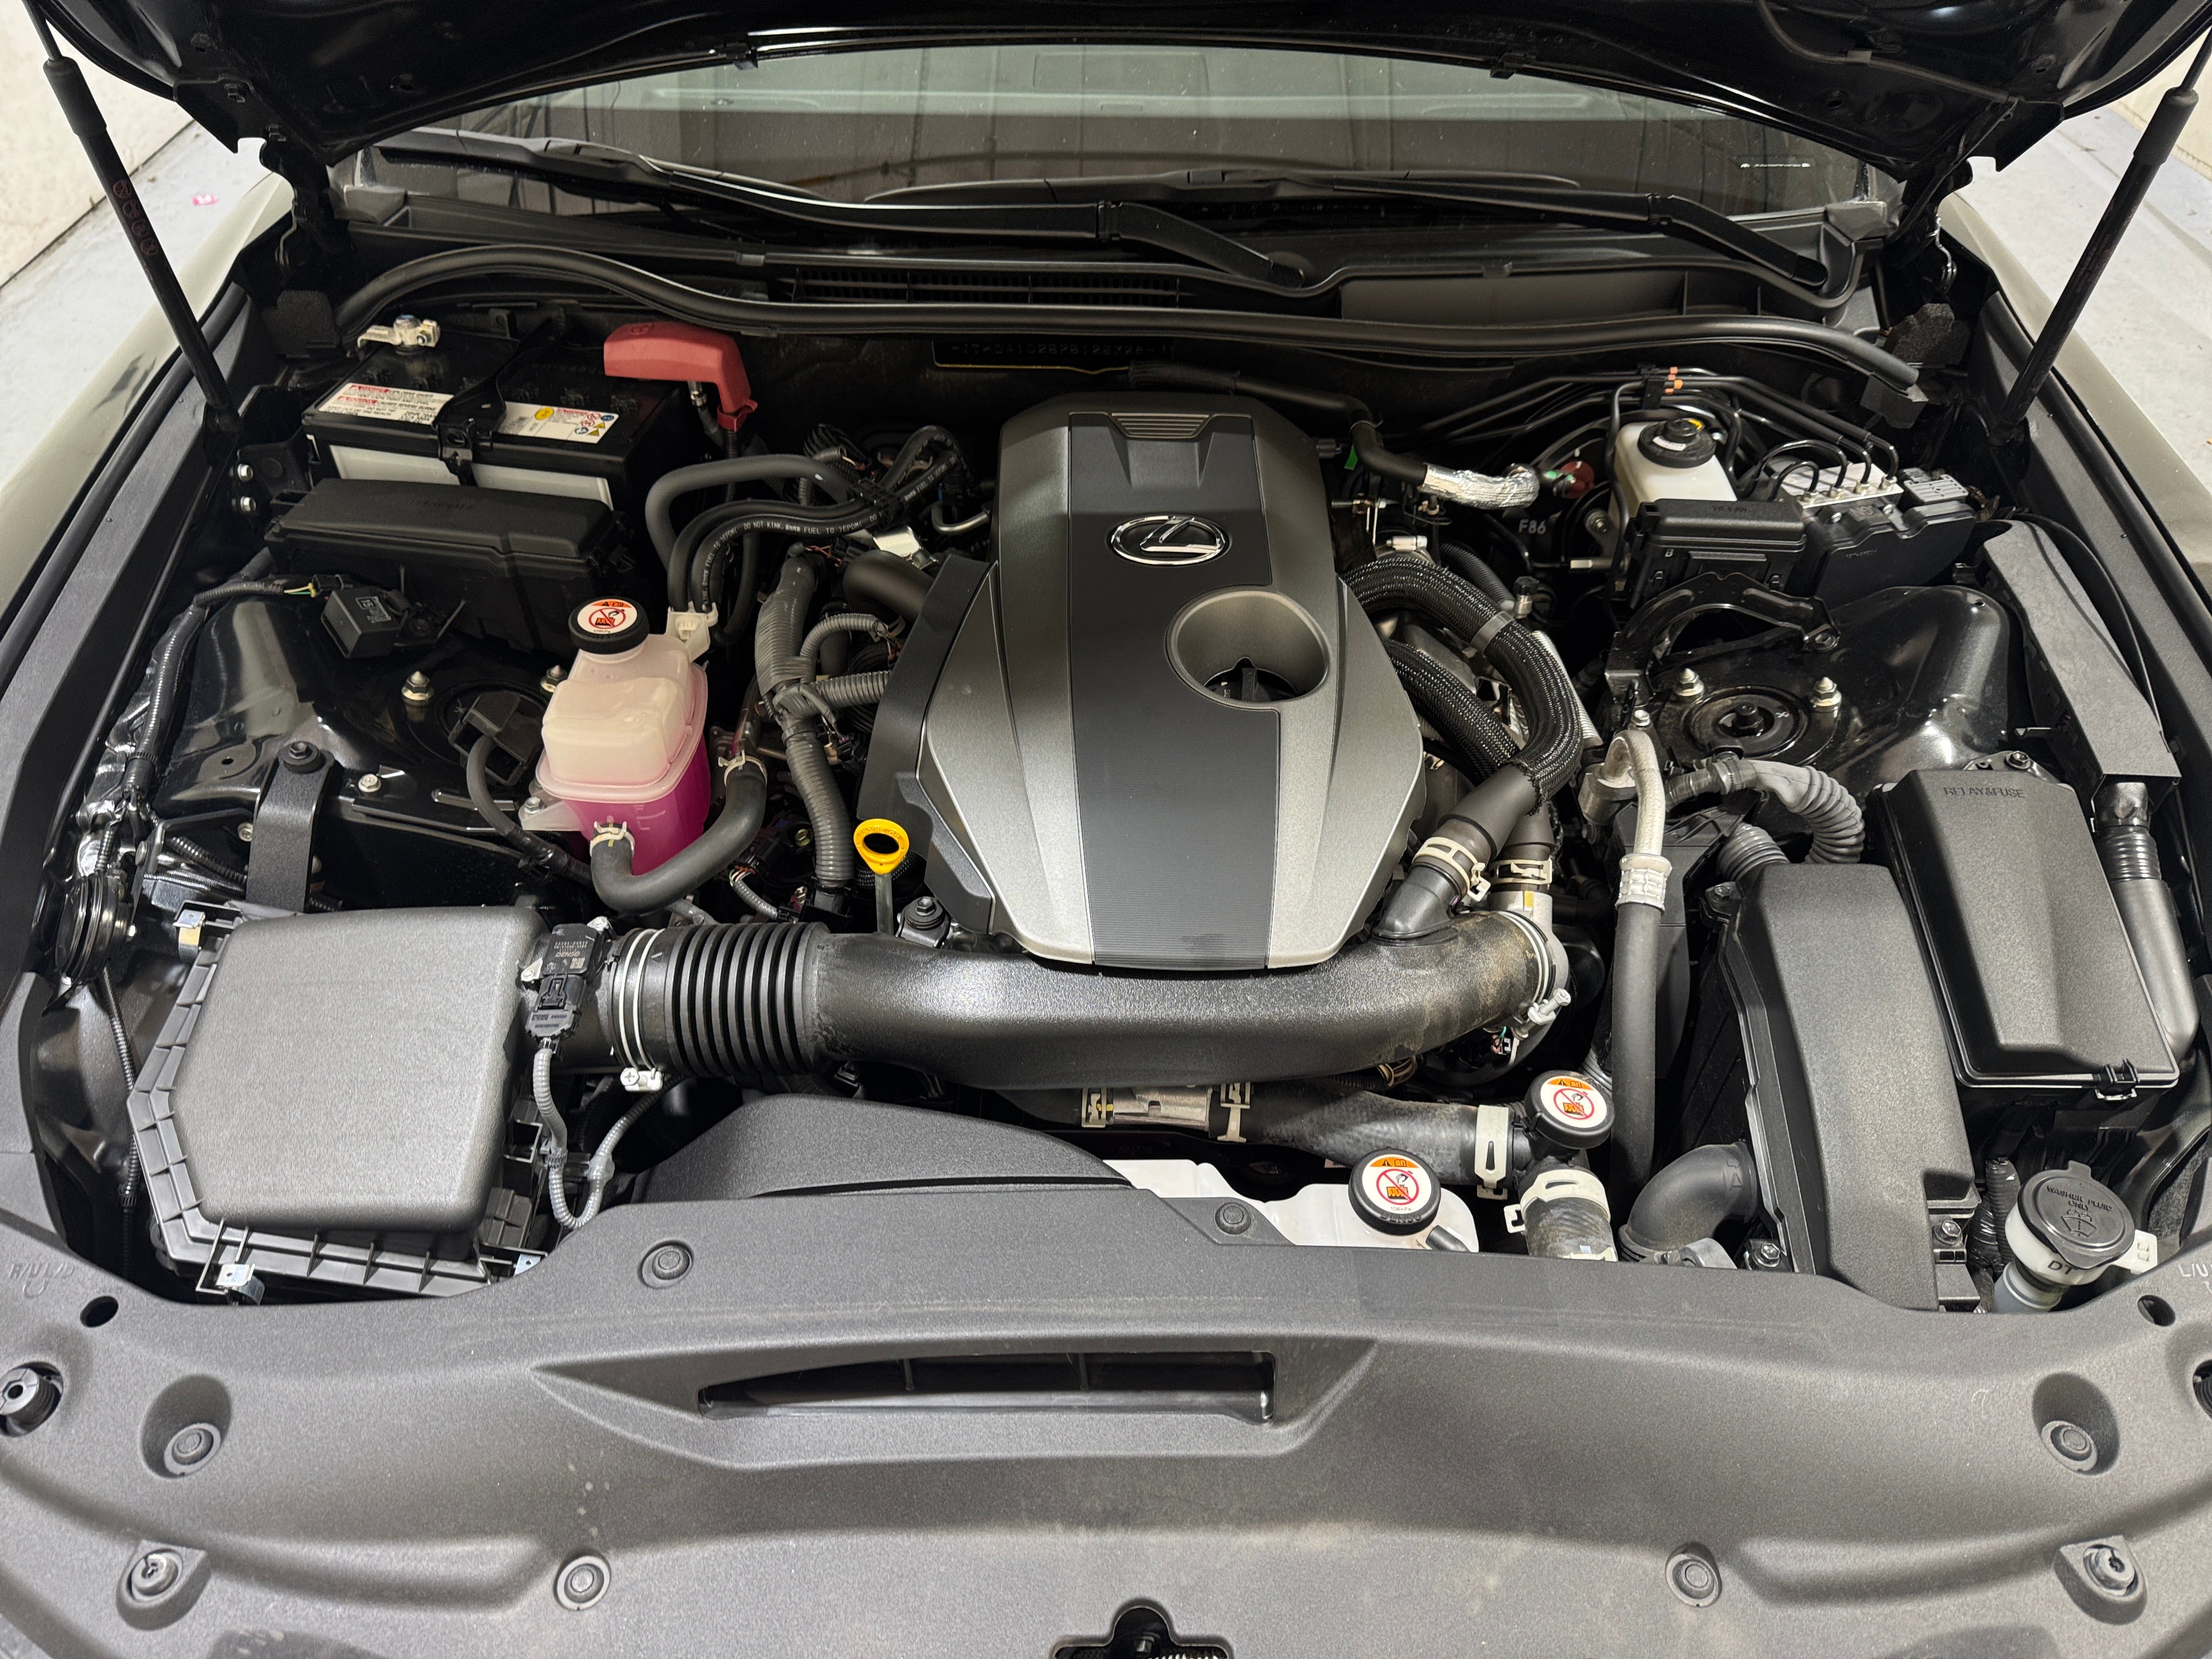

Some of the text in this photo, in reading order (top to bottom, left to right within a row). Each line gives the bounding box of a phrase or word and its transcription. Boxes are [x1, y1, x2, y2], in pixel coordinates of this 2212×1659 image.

[804, 526, 821, 534] FUEL
[1519, 519, 1546, 534] F86
[705, 552, 715, 567] FUEL
[713, 541, 721, 550] TO
[2047, 1186, 2113, 1211] WASHER FLUID
[1380, 1211, 1422, 1223] DENSO
[2047, 1260, 2078, 1275] DT
